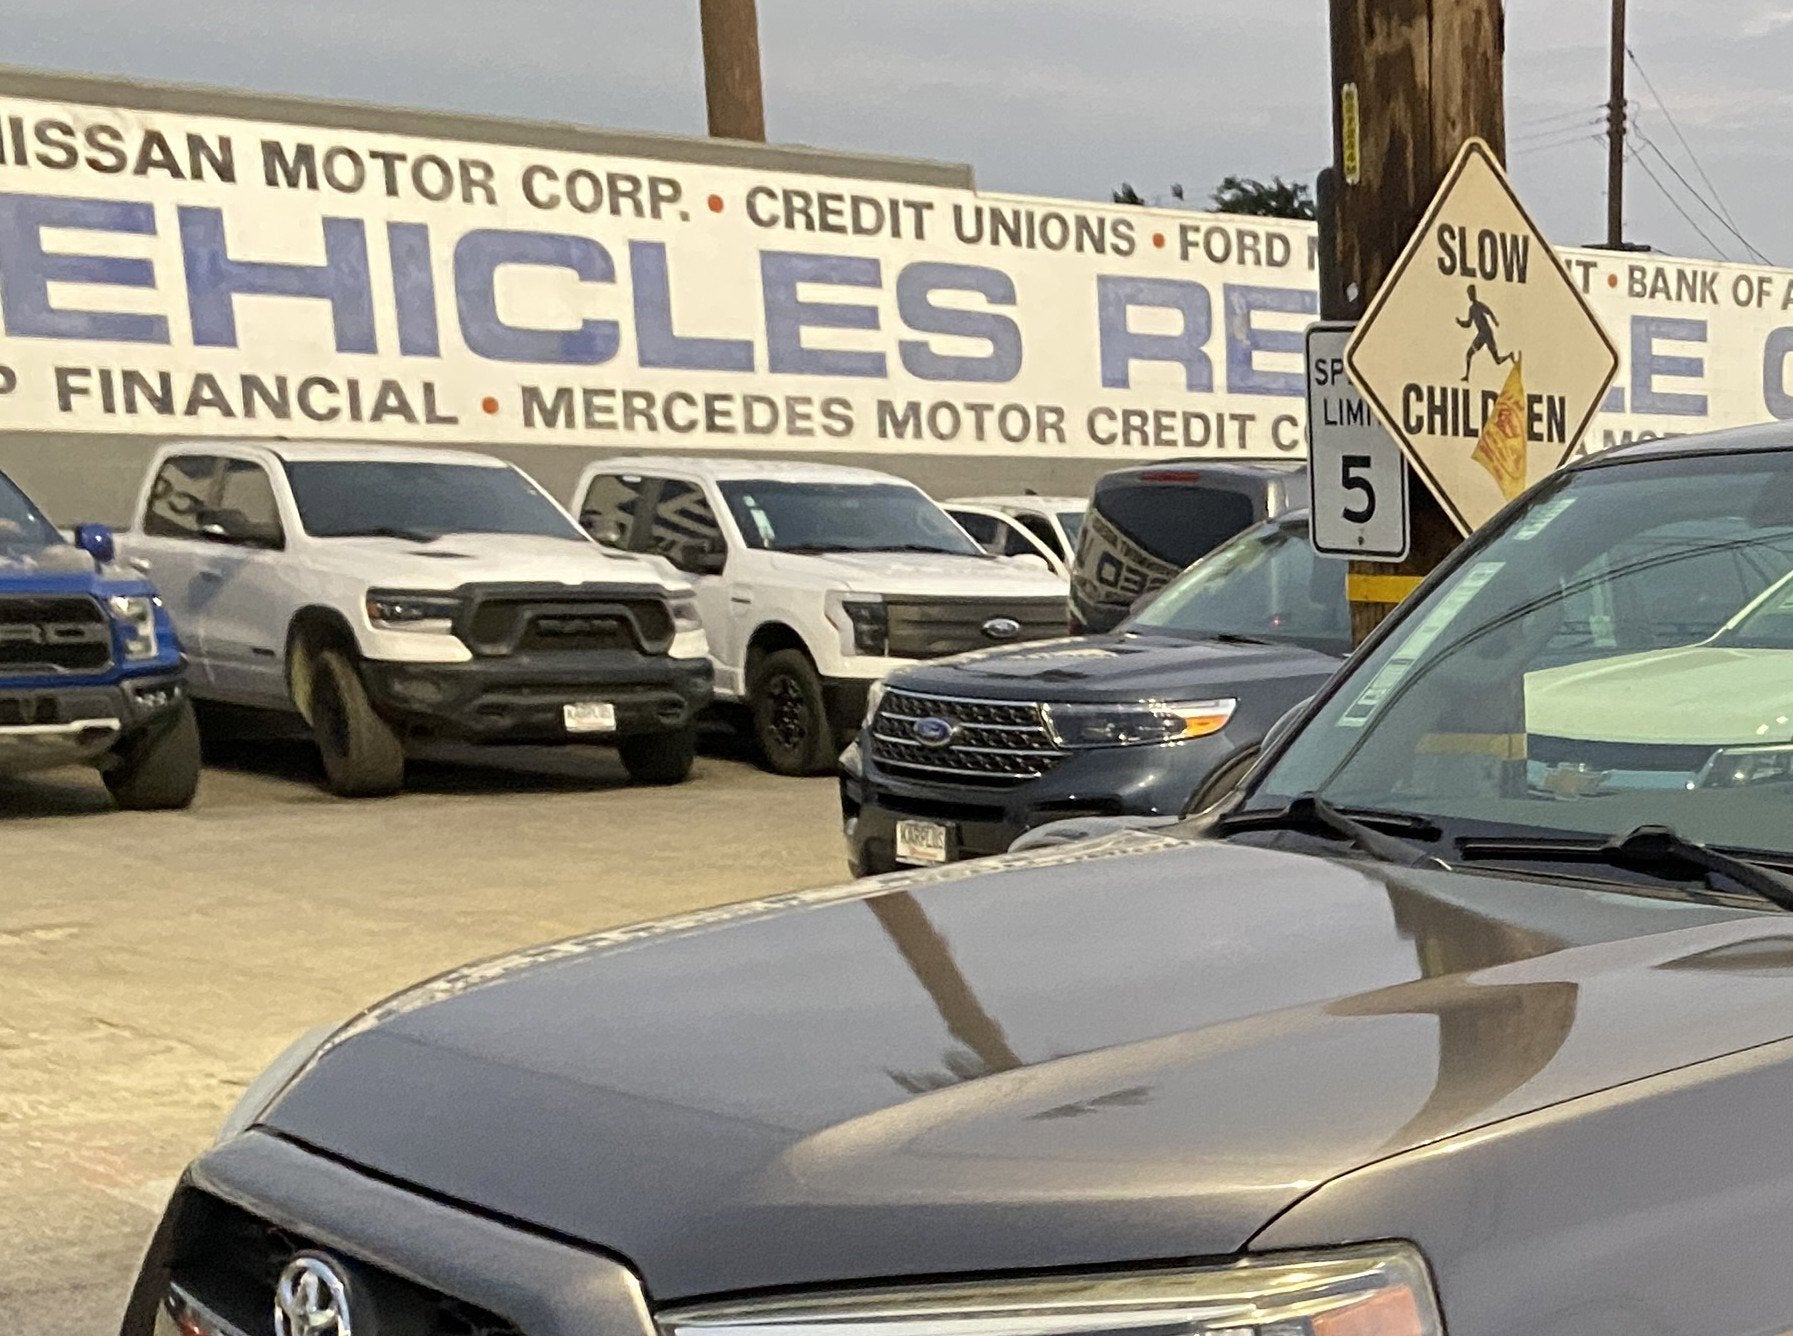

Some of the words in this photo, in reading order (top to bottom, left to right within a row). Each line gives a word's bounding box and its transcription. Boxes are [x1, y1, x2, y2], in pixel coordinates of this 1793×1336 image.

[0, 116, 235, 183] ISSAN
[263, 140, 498, 208] MOTOR
[521, 164, 690, 222] CORP.
[746, 185, 934, 242] CREDIT
[953, 204, 1136, 258] UNIONS
[1179, 223, 1291, 268] FORD
[1628, 264, 1719, 305] BANK
[1732, 274, 1773, 308] OF
[1437, 222, 1529, 284] SLOW
[0, 192, 1024, 384] EHICLES
[55, 366, 458, 426] FINANCIAL
[522, 384, 853, 436] MERCEDES
[877, 400, 1066, 445] MOTOR
[1087, 405, 1254, 451] CREDIT
[1324, 398, 1382, 427] LIMI
[1403, 383, 1566, 443] CHILDEN
[1341, 455, 1376, 524] 5
